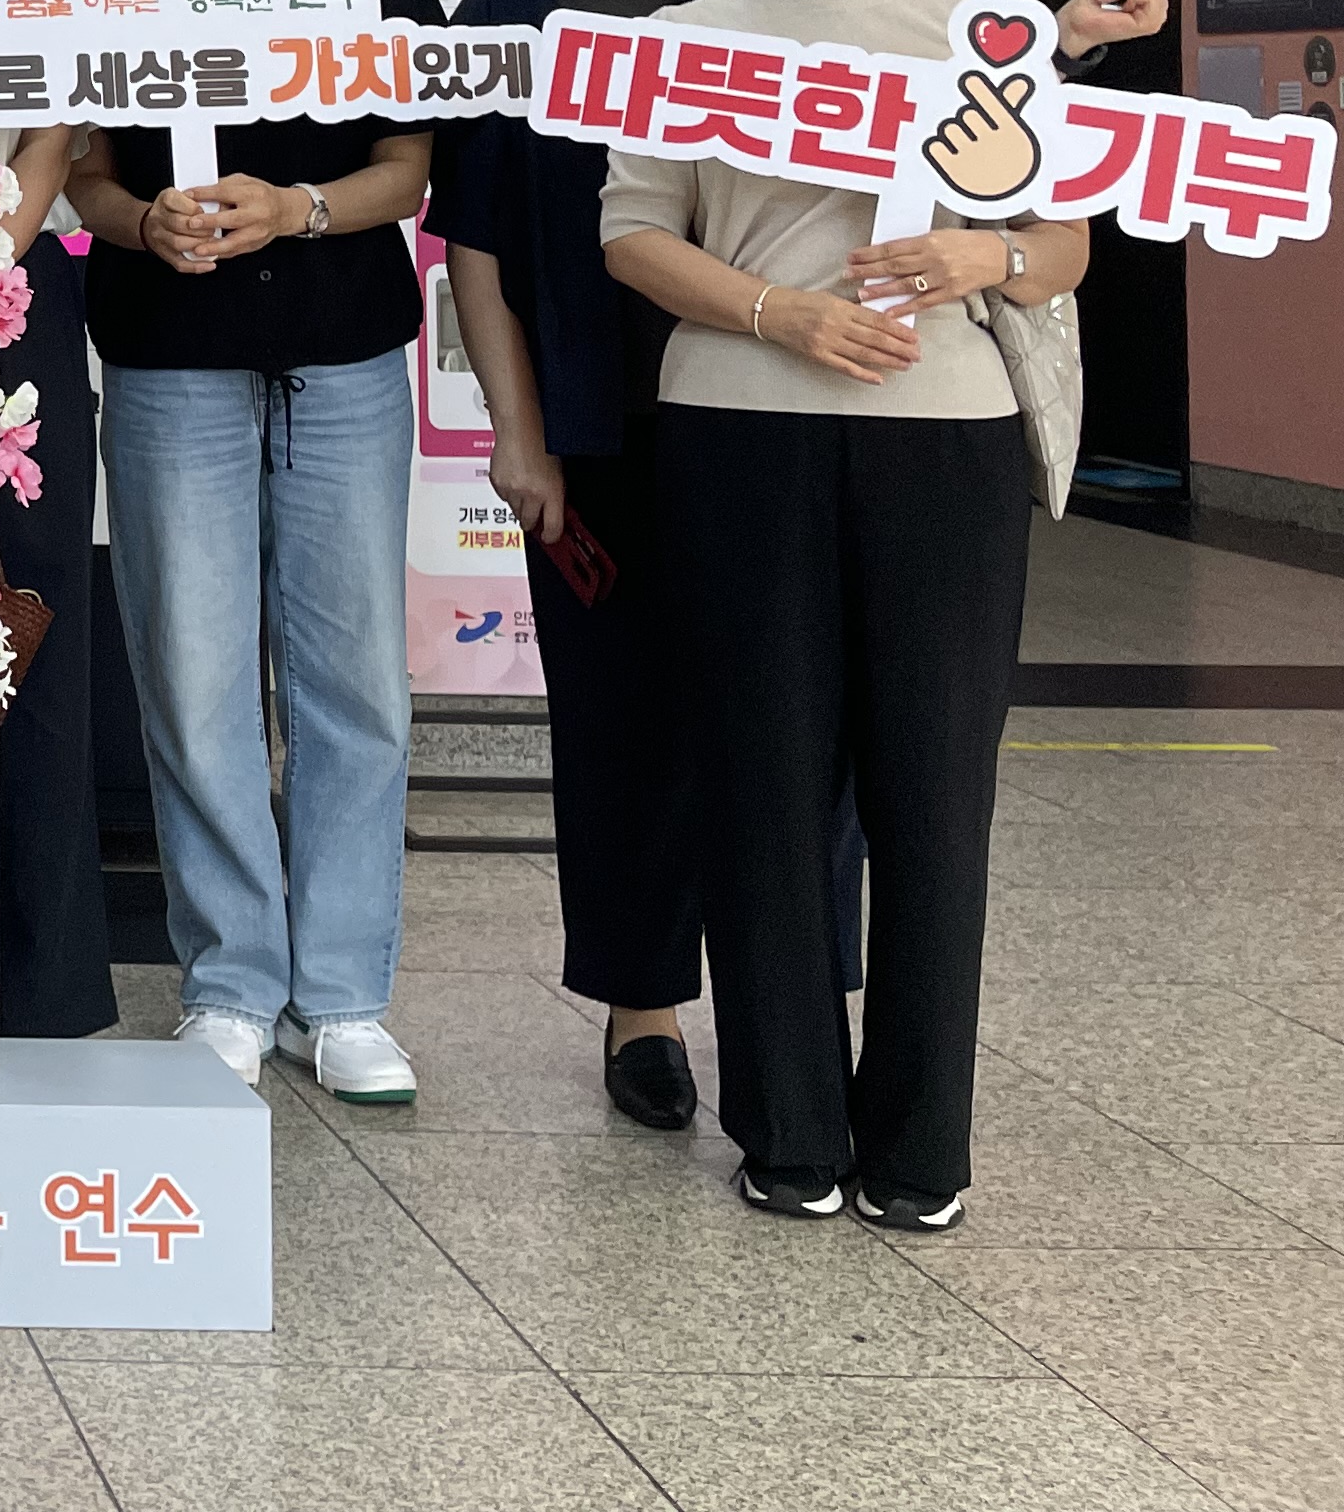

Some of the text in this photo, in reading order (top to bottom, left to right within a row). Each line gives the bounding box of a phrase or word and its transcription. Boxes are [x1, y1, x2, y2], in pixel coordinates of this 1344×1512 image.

[68, 48, 251, 110] 세상을
[268, 34, 533, 107] 가치있게
[545, 28, 1313, 240] 따뜻한 기부
[459, 507, 488, 524] 기부
[42, 1171, 204, 1265] 연수
